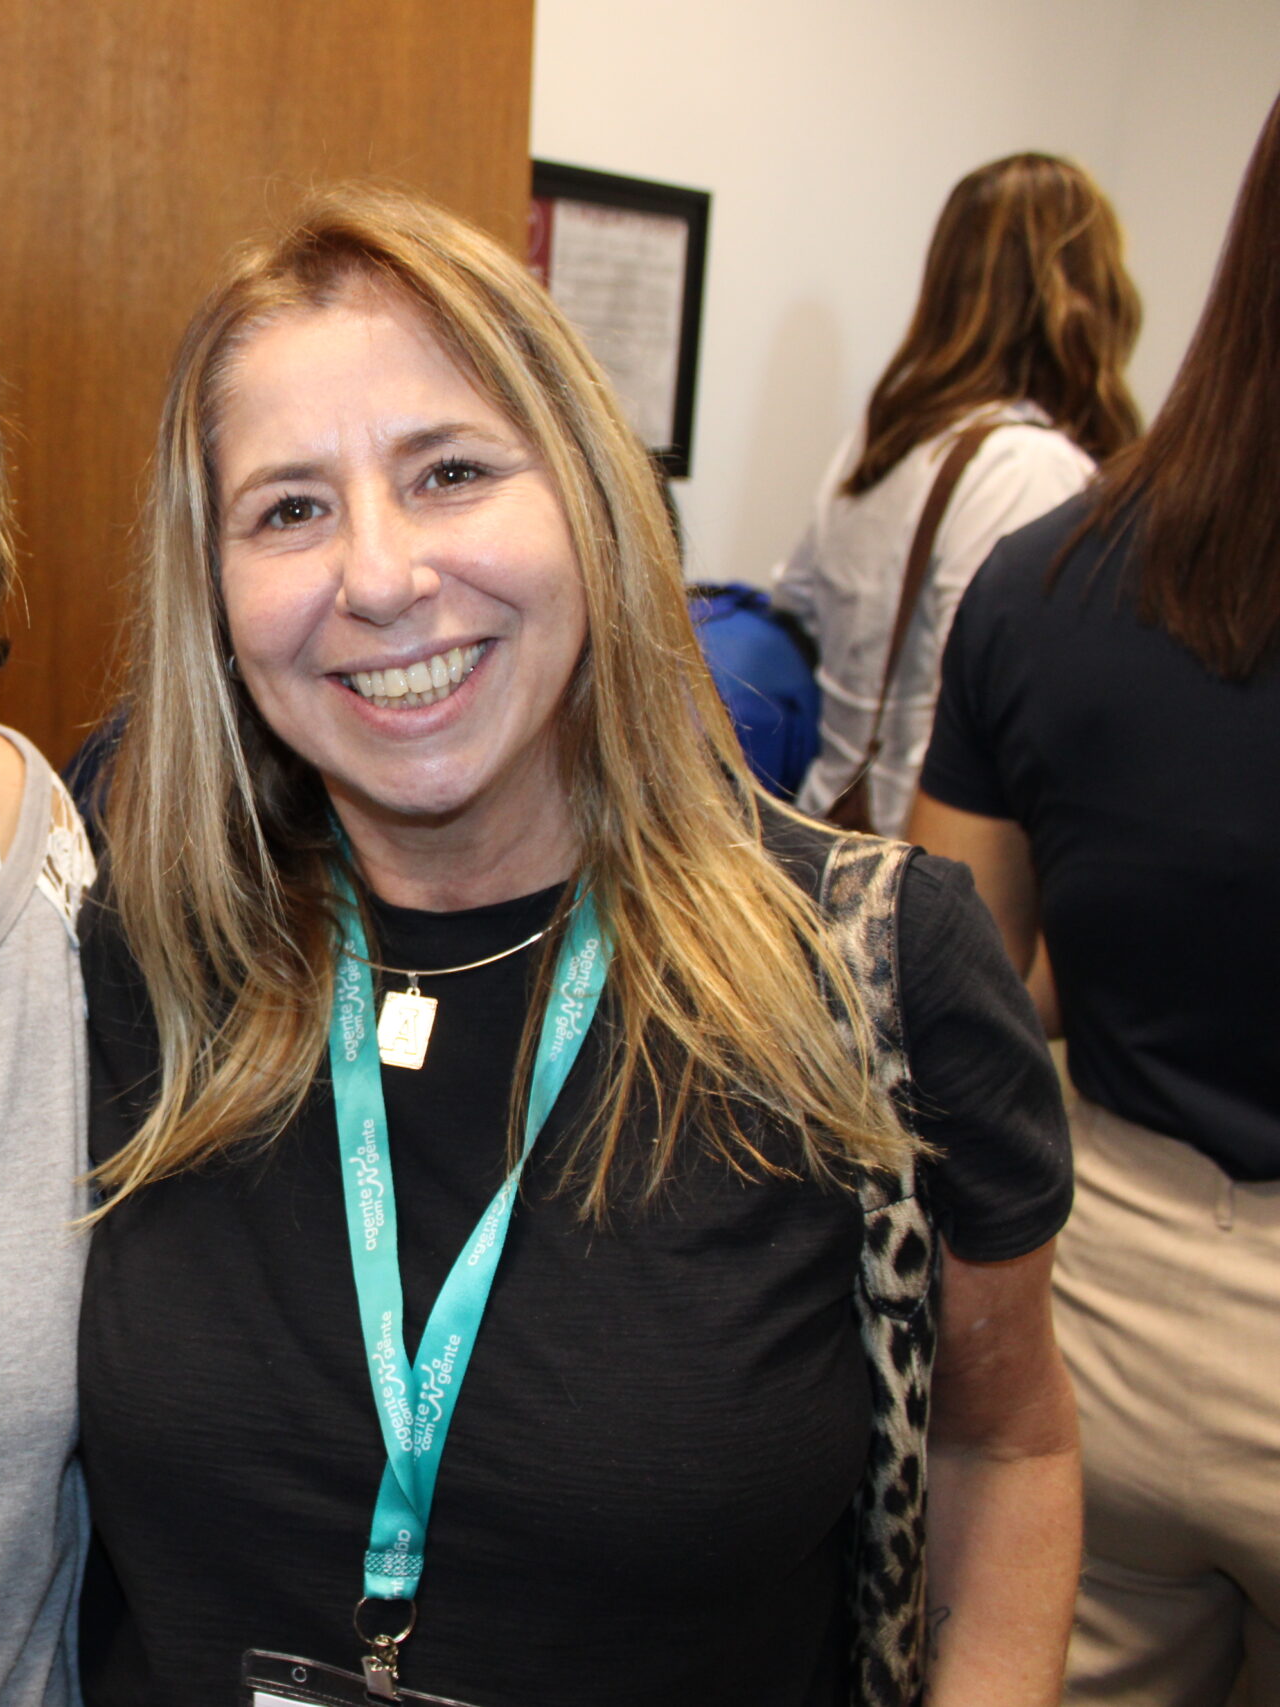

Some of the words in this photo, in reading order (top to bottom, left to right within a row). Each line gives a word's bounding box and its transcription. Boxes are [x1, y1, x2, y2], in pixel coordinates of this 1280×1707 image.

[345, 940, 361, 982] gene
[567, 956, 580, 980] com
[573, 939, 599, 998] agente
[340, 1003, 358, 1062] agente
[355, 1016, 365, 1040] com
[550, 1015, 568, 1061] gente
[362, 1119, 379, 1164] gente
[359, 1188, 378, 1251] agente
[375, 1200, 384, 1226] com
[380, 1311, 395, 1359] gente
[437, 1334, 461, 1384] gente
[383, 1386, 413, 1452] agente
[398, 1398, 414, 1425] com
[421, 1423, 436, 1451] com
